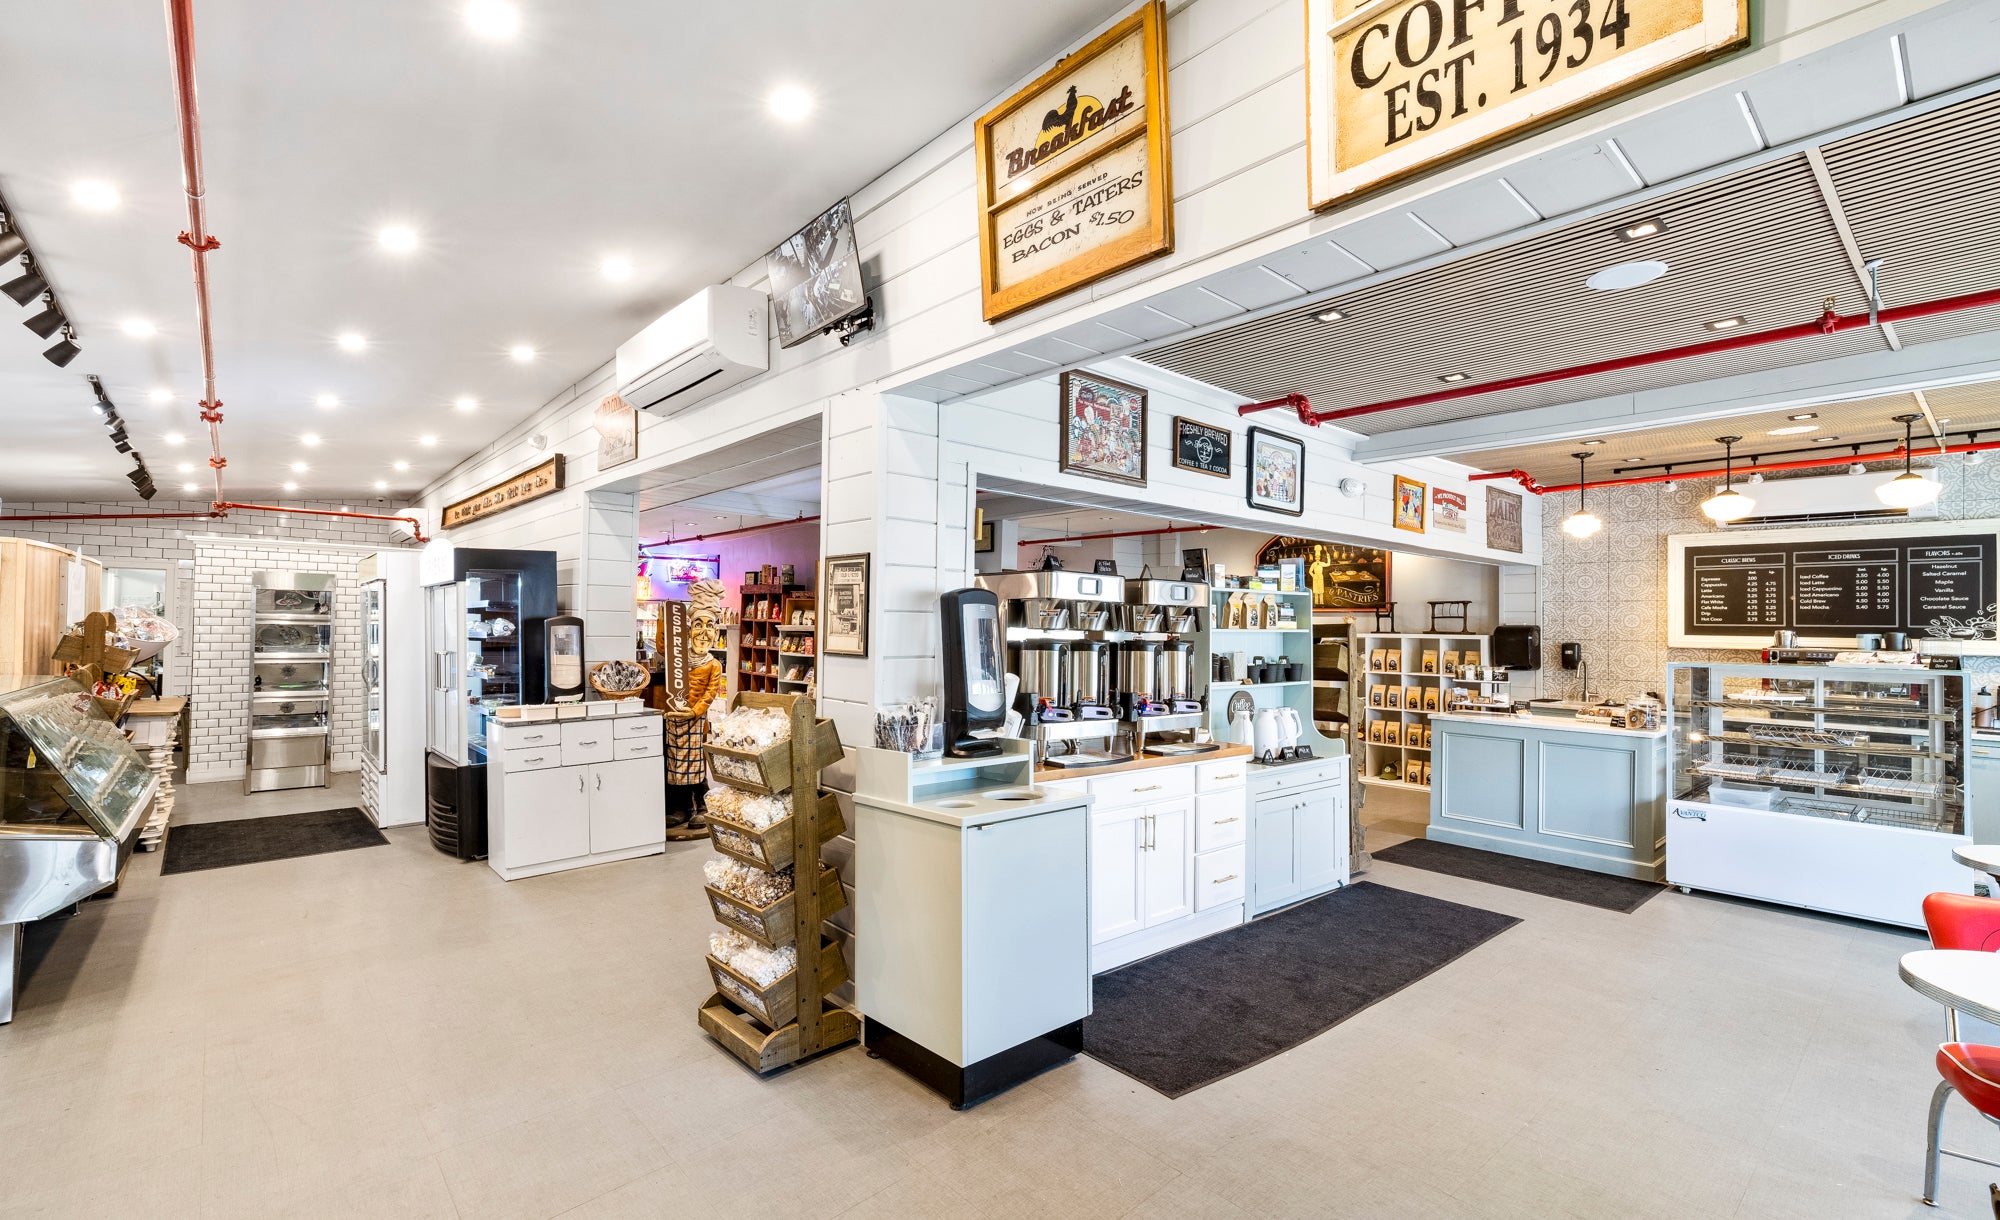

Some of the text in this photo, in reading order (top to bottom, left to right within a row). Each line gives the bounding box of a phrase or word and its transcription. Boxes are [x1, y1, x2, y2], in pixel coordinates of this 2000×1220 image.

[1384, 0, 1630, 147] EST. 1934
[1006, 85, 1134, 178] Breakfast
[1003, 170, 1143, 250] EGGS & TATERS
[1027, 172, 1108, 218] NOW BEING SERVED
[1012, 222, 1061, 263] BACON
[1180, 422, 1203, 436] FRESHLY
[1204, 427, 1228, 447] BREWED
[1200, 462, 1208, 470] TEA
[1213, 465, 1228, 474] COCOA
[1489, 495, 1520, 523] DAIRY
[1337, 588, 1379, 603] PASTRIES
[672, 604, 684, 689] ESPRESSO
